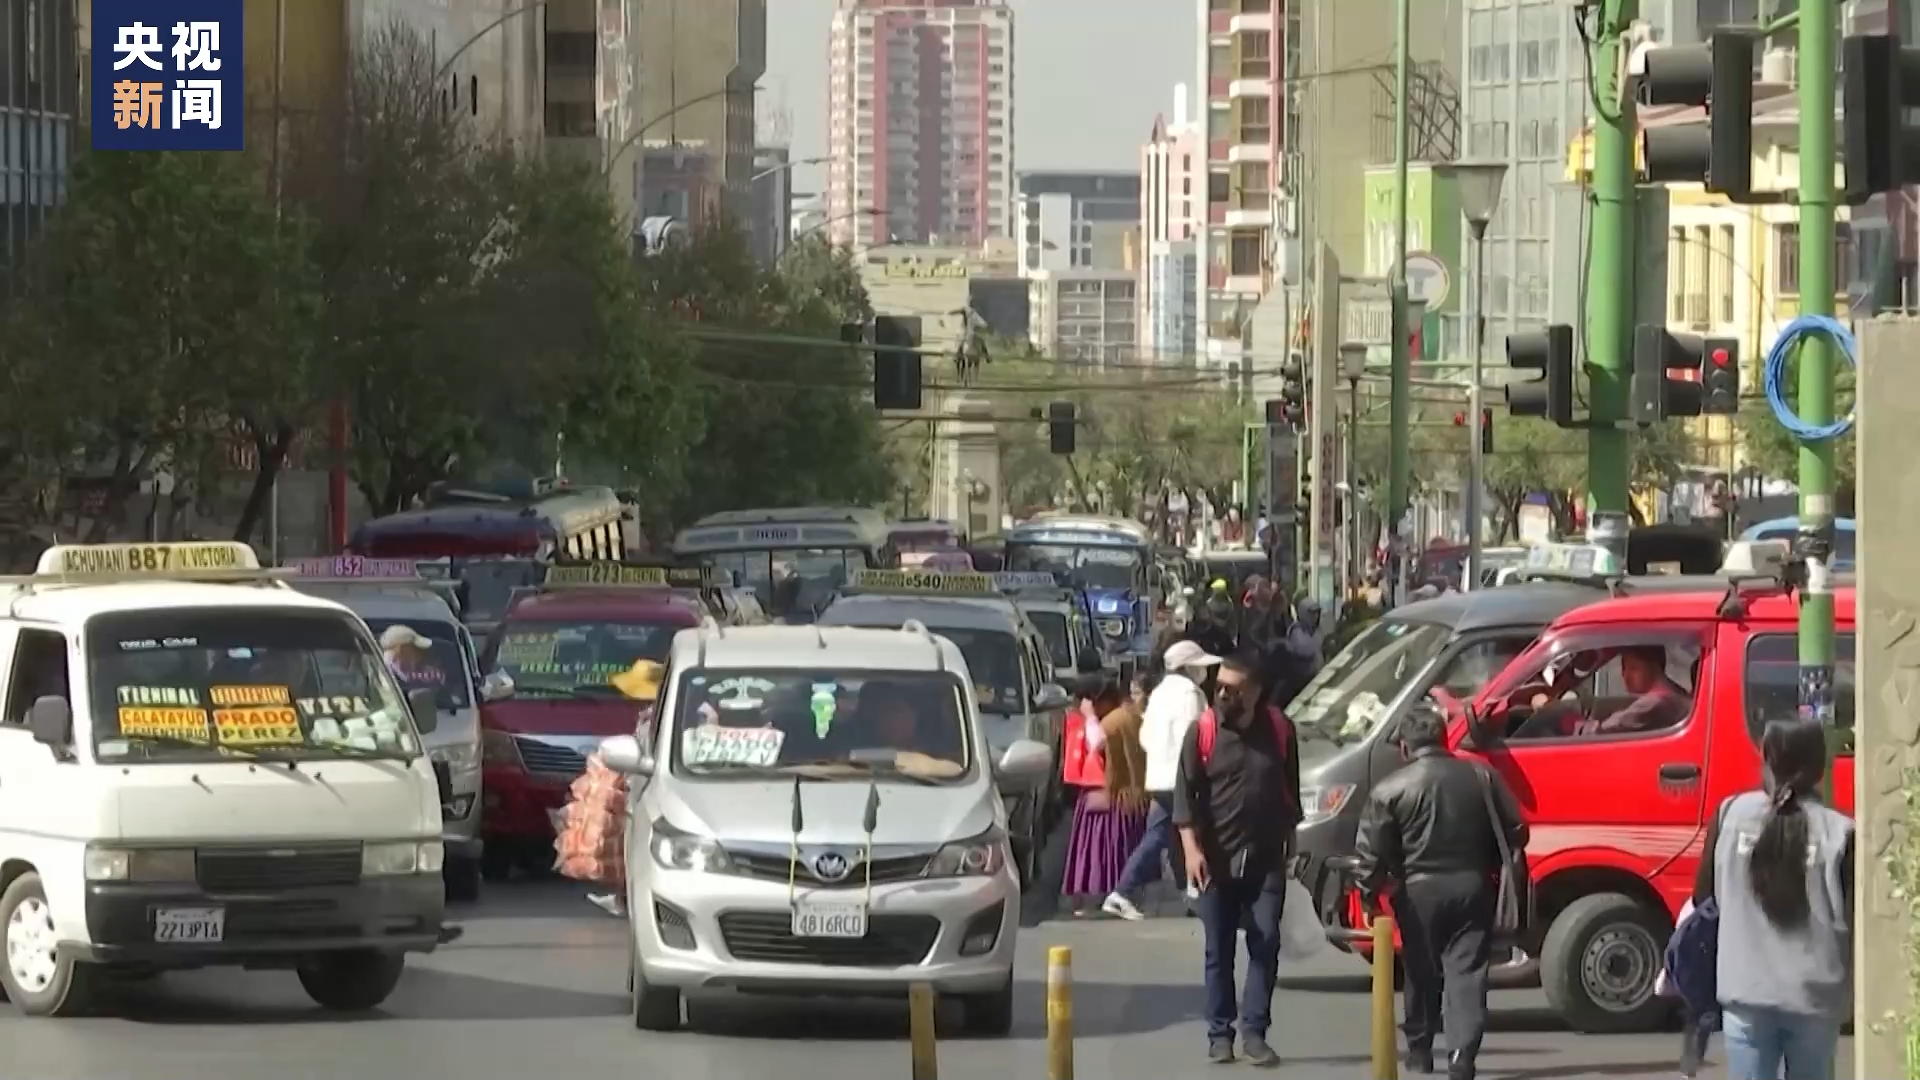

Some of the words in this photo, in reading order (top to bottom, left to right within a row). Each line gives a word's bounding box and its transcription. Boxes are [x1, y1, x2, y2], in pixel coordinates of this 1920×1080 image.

[65, 549, 125, 573] ACHUMANI
[128, 547, 172, 570] 887
[334, 557, 362, 577] 852
[913, 573, 941, 589] 540
[122, 709, 206, 726] CALATAYUD
[216, 710, 296, 726] PRADO
[221, 727, 298, 740] PEREZ
